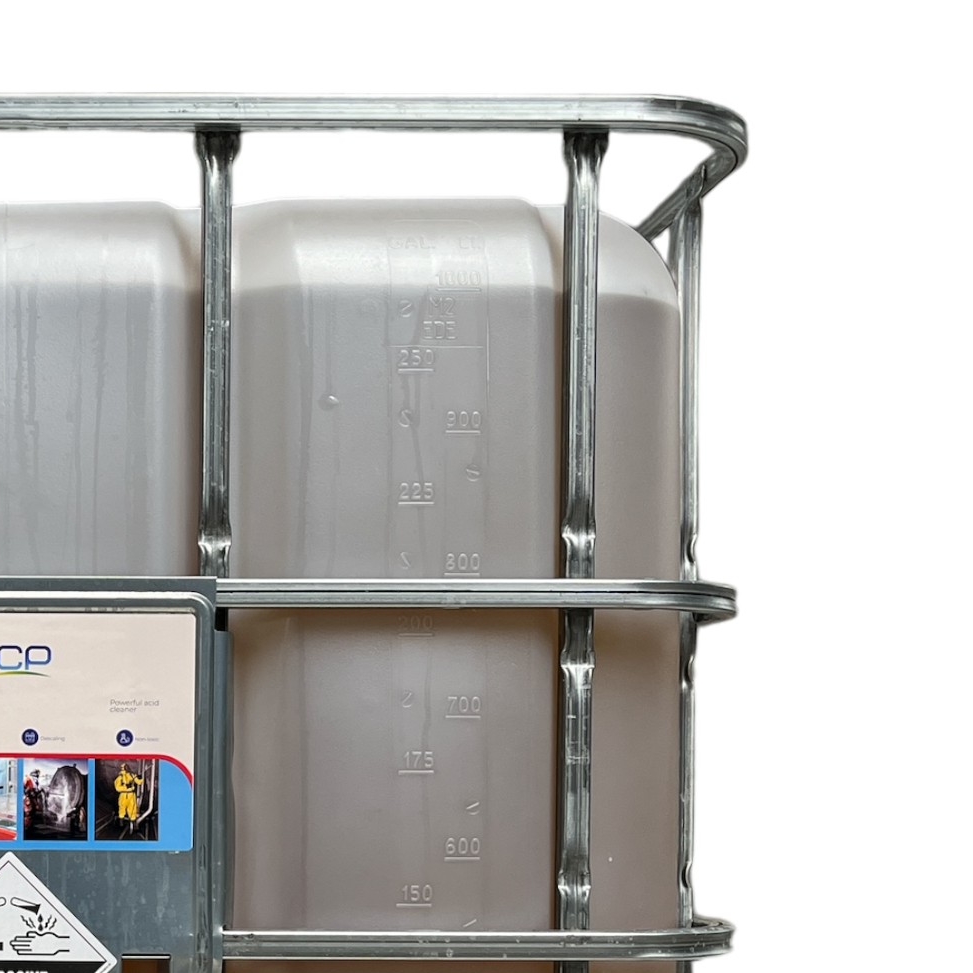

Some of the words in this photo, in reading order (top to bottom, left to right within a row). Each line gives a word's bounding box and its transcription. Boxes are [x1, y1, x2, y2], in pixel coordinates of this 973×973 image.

[436, 270, 481, 285] 1000
[398, 350, 434, 365] 250
[446, 411, 481, 426] 900
[399, 483, 434, 499] 225
[445, 553, 480, 570] 800
[398, 616, 433, 631] 200
[448, 697, 481, 712] 700
[404, 752, 434, 768] 175
[445, 838, 480, 854] 600
[402, 885, 432, 901] 150
